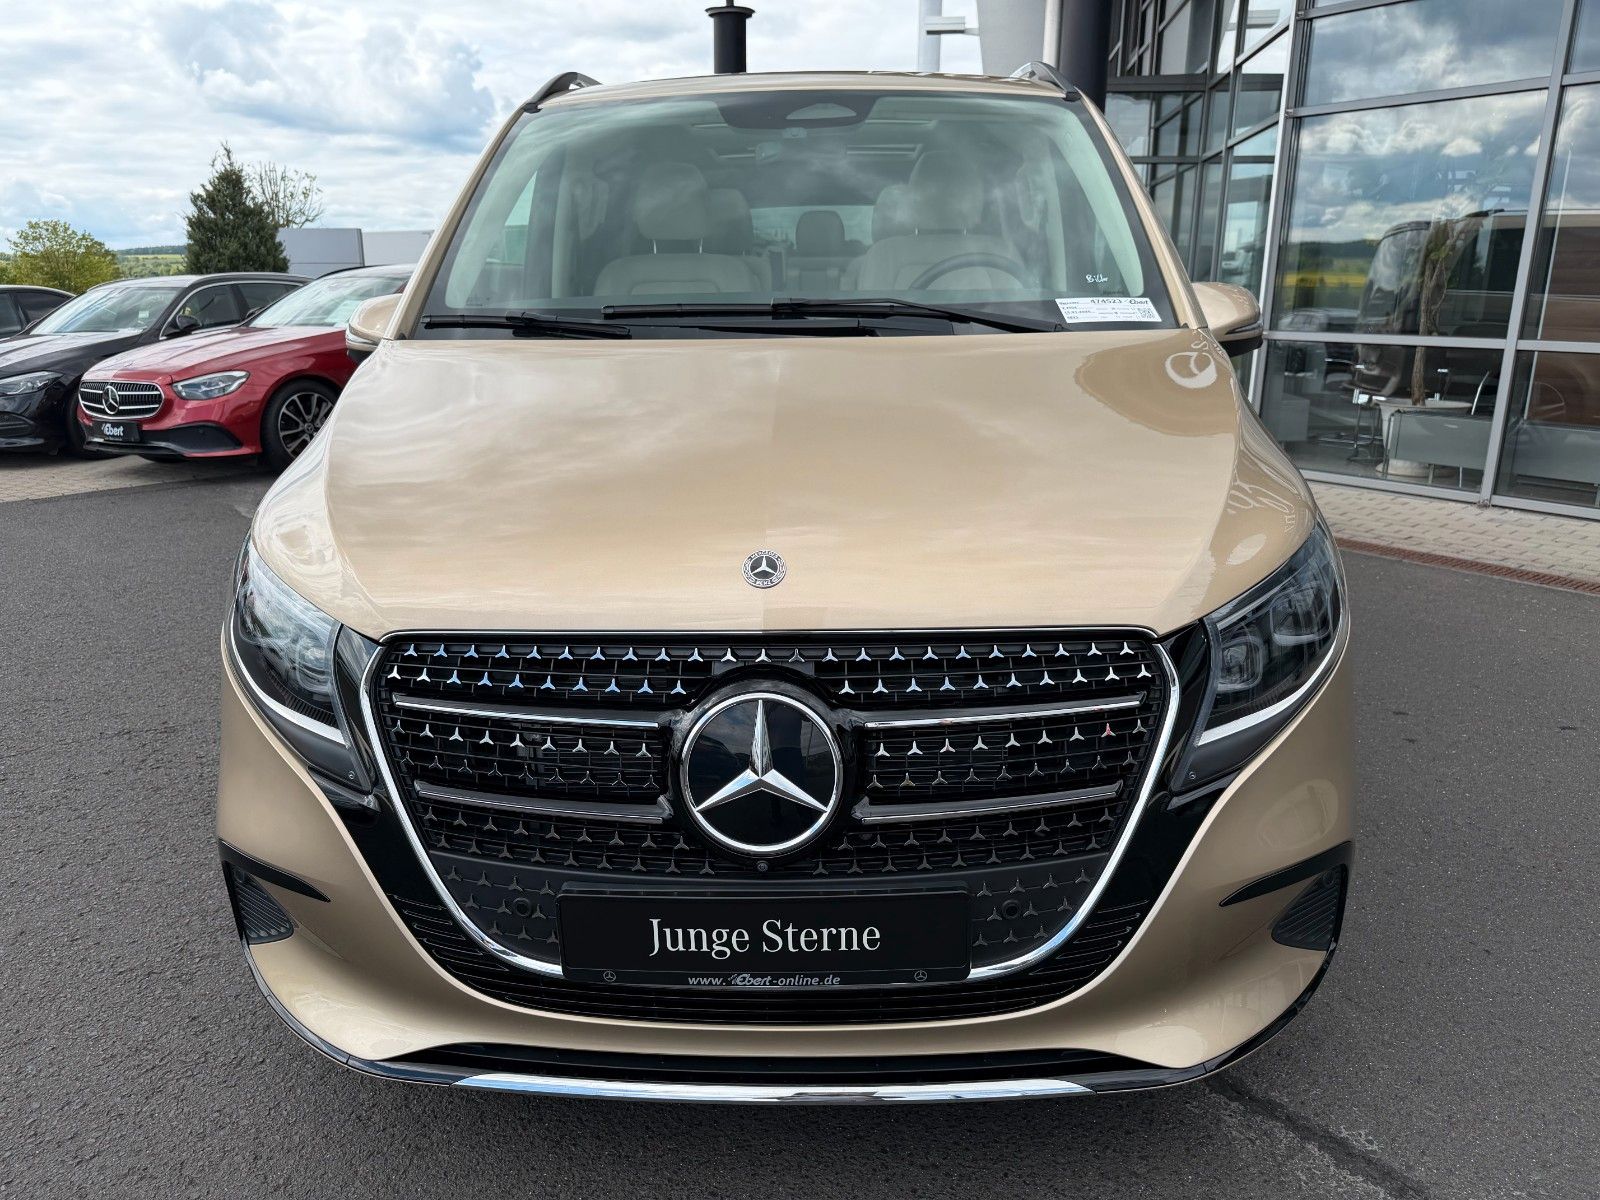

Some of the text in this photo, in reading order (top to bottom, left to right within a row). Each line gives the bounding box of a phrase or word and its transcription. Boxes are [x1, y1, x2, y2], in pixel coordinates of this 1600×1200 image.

[103, 423, 124, 436] Ebert
[649, 918, 881, 960] Junge Sterne
[688, 973, 841, 987] www.Ebert-online.de
